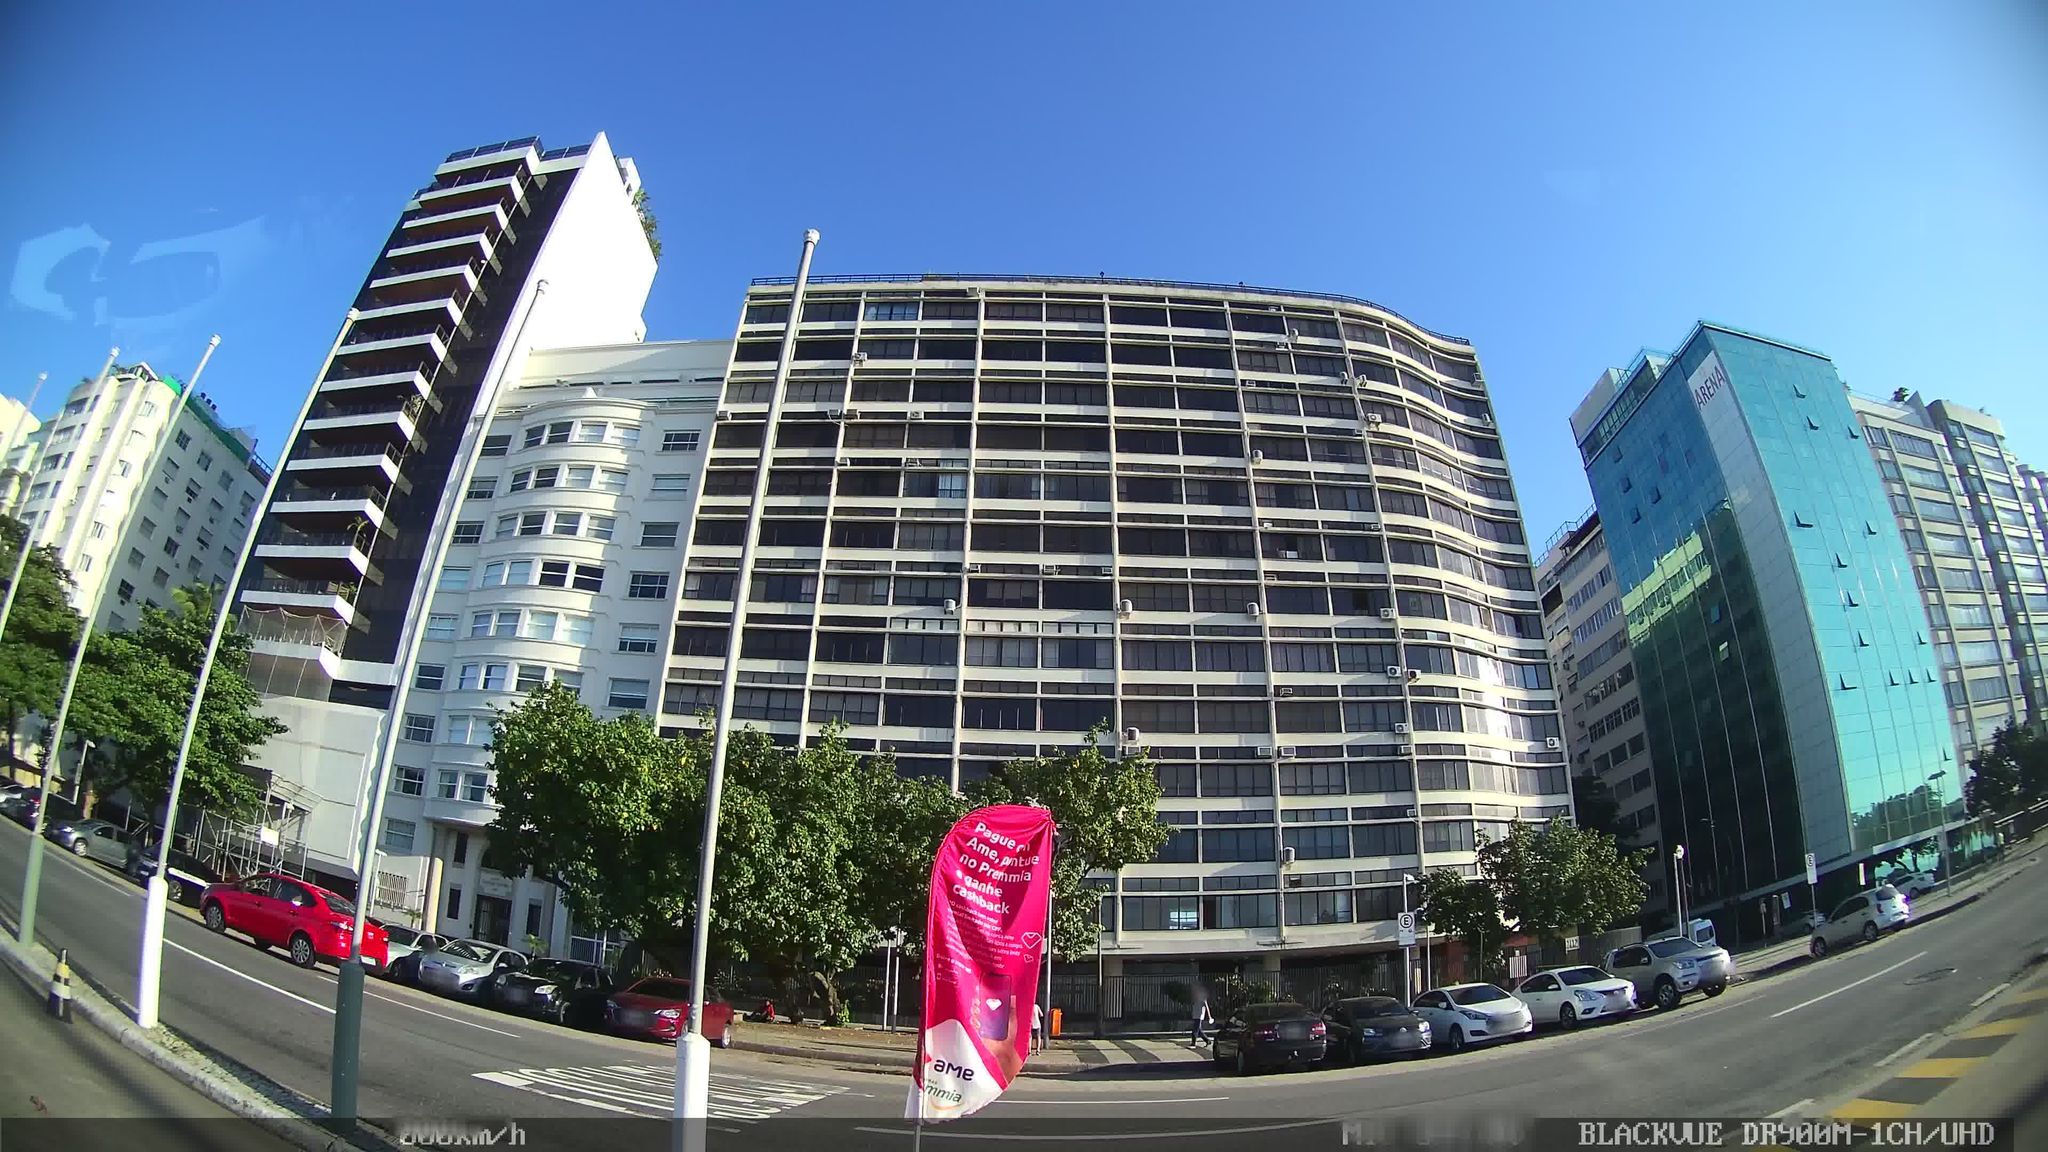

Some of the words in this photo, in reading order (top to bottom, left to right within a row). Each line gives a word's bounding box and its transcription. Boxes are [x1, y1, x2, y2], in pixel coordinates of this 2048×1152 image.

[1694, 365, 1725, 410] ARENA
[975, 823, 1016, 849] Pague
[959, 854, 977, 869] no
[966, 837, 999, 864] Ame,
[952, 884, 1010, 914] cashback
[1403, 917, 1410, 926] E
